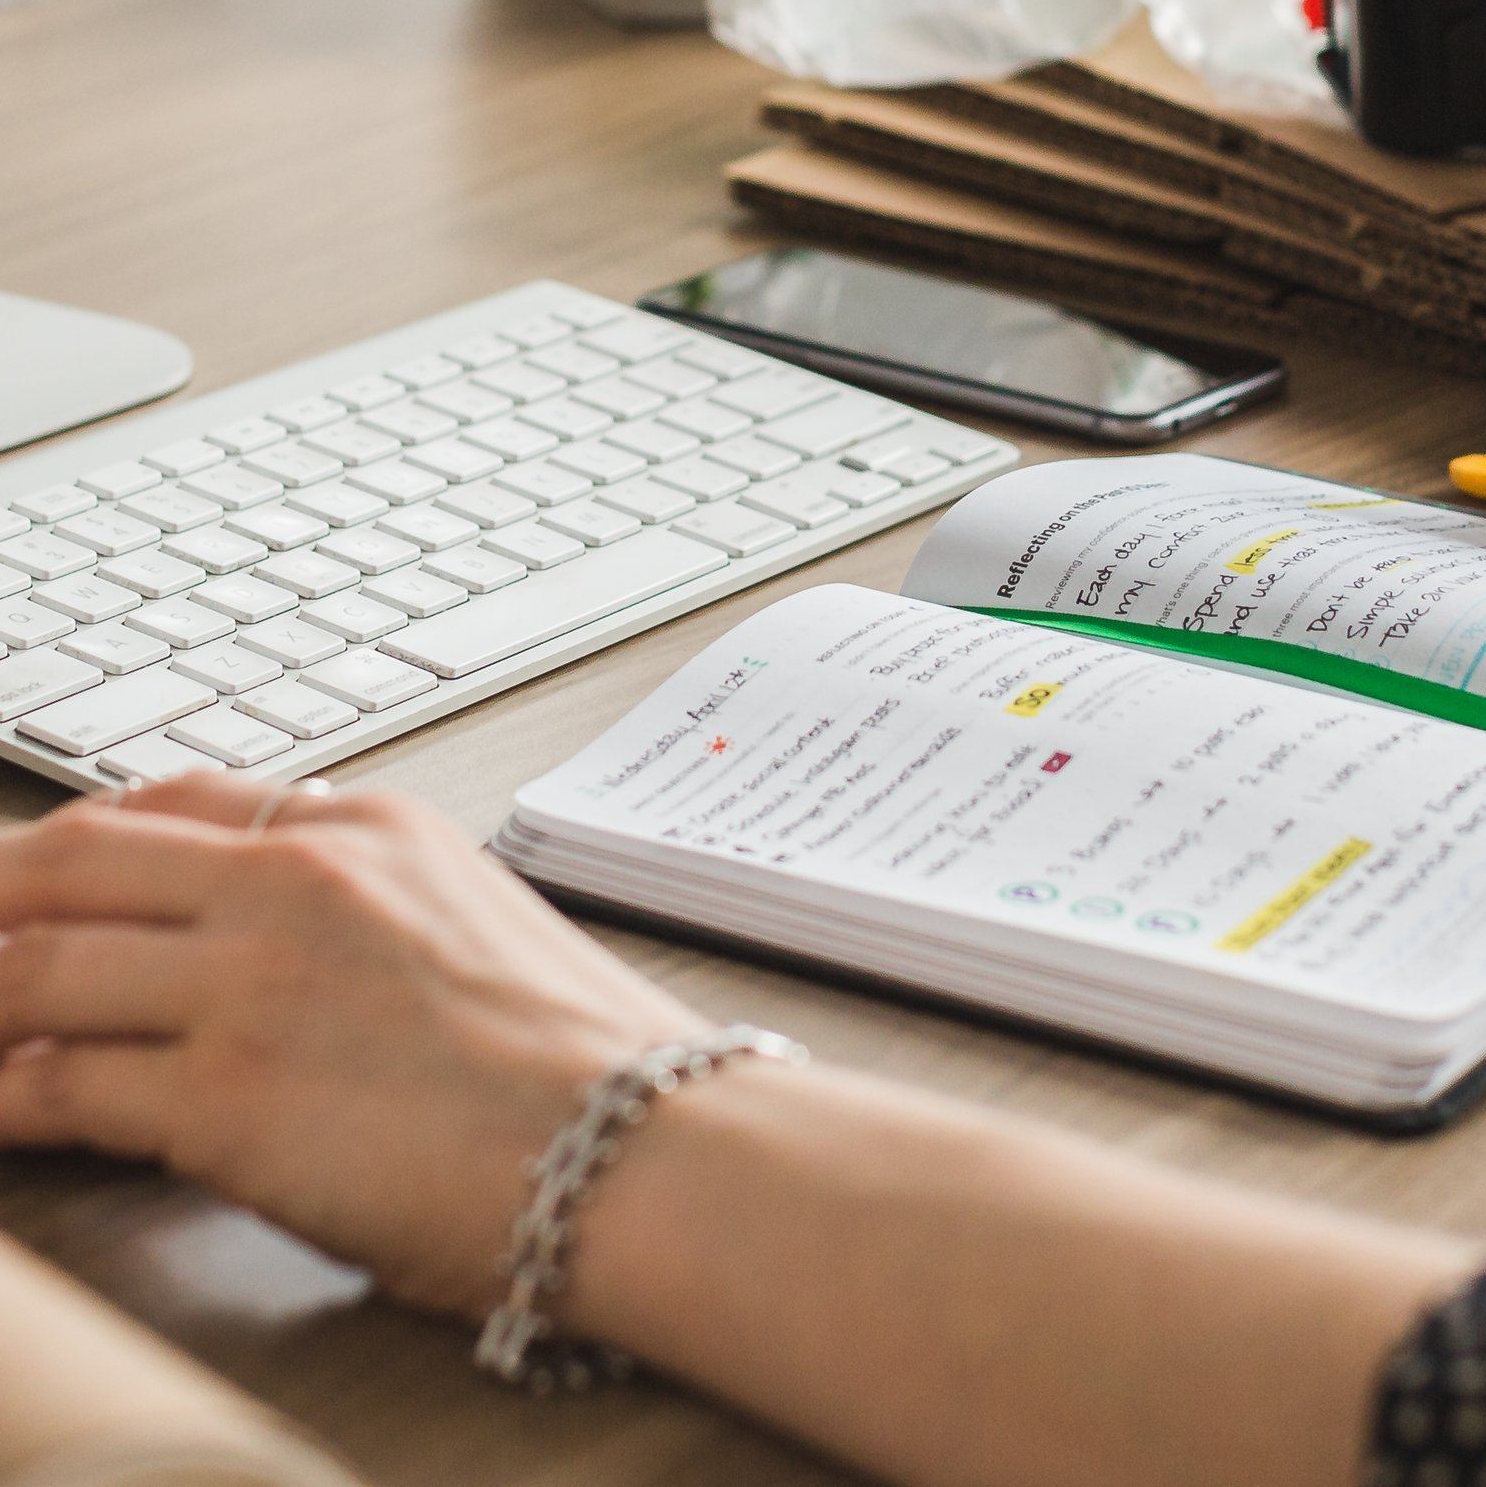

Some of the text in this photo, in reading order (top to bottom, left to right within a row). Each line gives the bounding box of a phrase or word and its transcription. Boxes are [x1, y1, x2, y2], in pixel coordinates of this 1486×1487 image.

[996, 522, 1067, 599] Reflecting
[1062, 507, 1081, 522] on
[1075, 497, 1101, 514] the
[1046, 555, 1084, 610] Reviewing
[1079, 542, 1094, 558] my
[1076, 564, 1117, 608] Each
[1114, 531, 1156, 561] day
[1113, 522, 1208, 617] my comfort
[1249, 570, 1287, 598] use
[1280, 547, 1319, 568] that
[1172, 581, 1191, 598] one
[1183, 562, 1209, 584] thing
[1183, 573, 1240, 633] Spend
[1232, 547, 1274, 567] less
[1306, 572, 1375, 633] Don't be
[1271, 613, 1293, 639] three
[1288, 593, 1311, 616] most
[1345, 587, 1408, 641] Simple
[1378, 605, 1432, 648] Take
[1422, 583, 1447, 603] an
[686, 693, 726, 724] April
